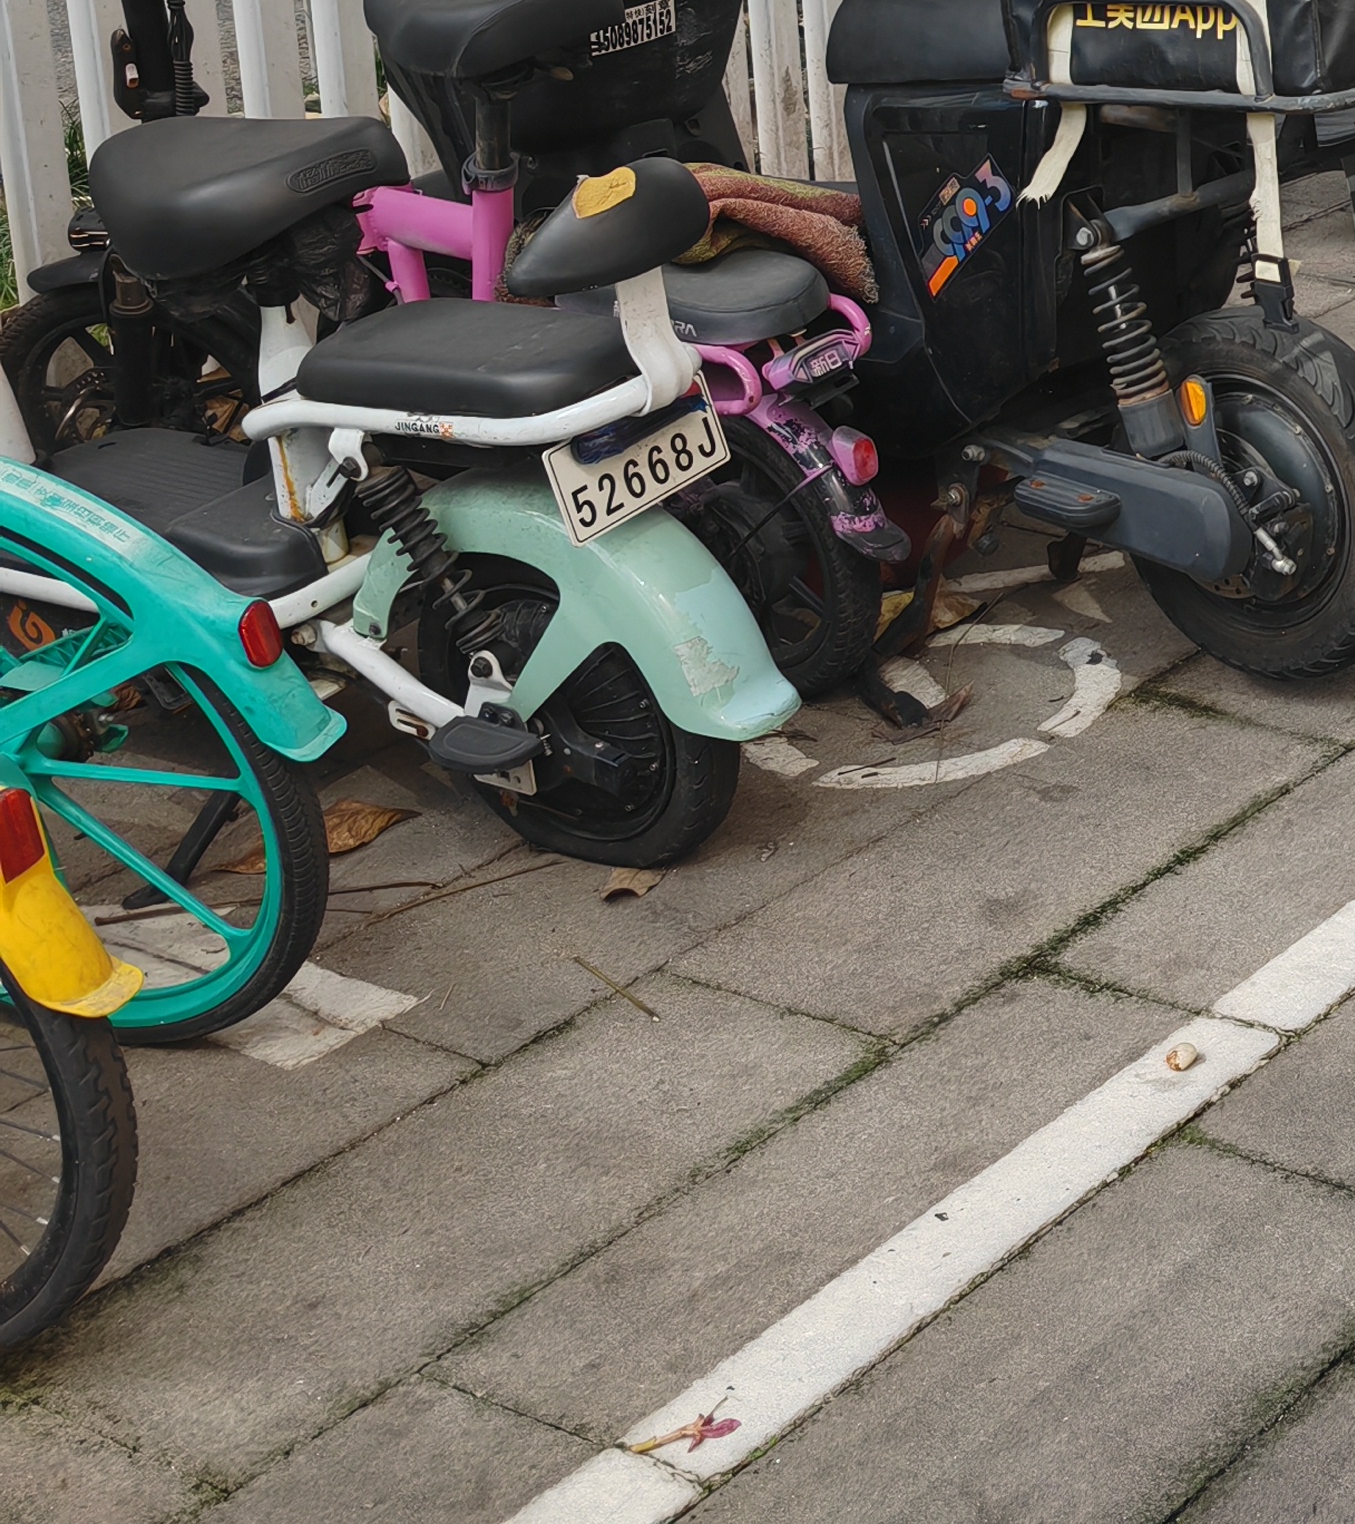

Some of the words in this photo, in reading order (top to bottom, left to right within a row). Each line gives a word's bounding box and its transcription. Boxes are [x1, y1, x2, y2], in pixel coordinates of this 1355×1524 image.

[809, 349, 843, 377] 新日
[394, 422, 440, 434] JINGANG
[571, 416, 717, 528] 52668J
